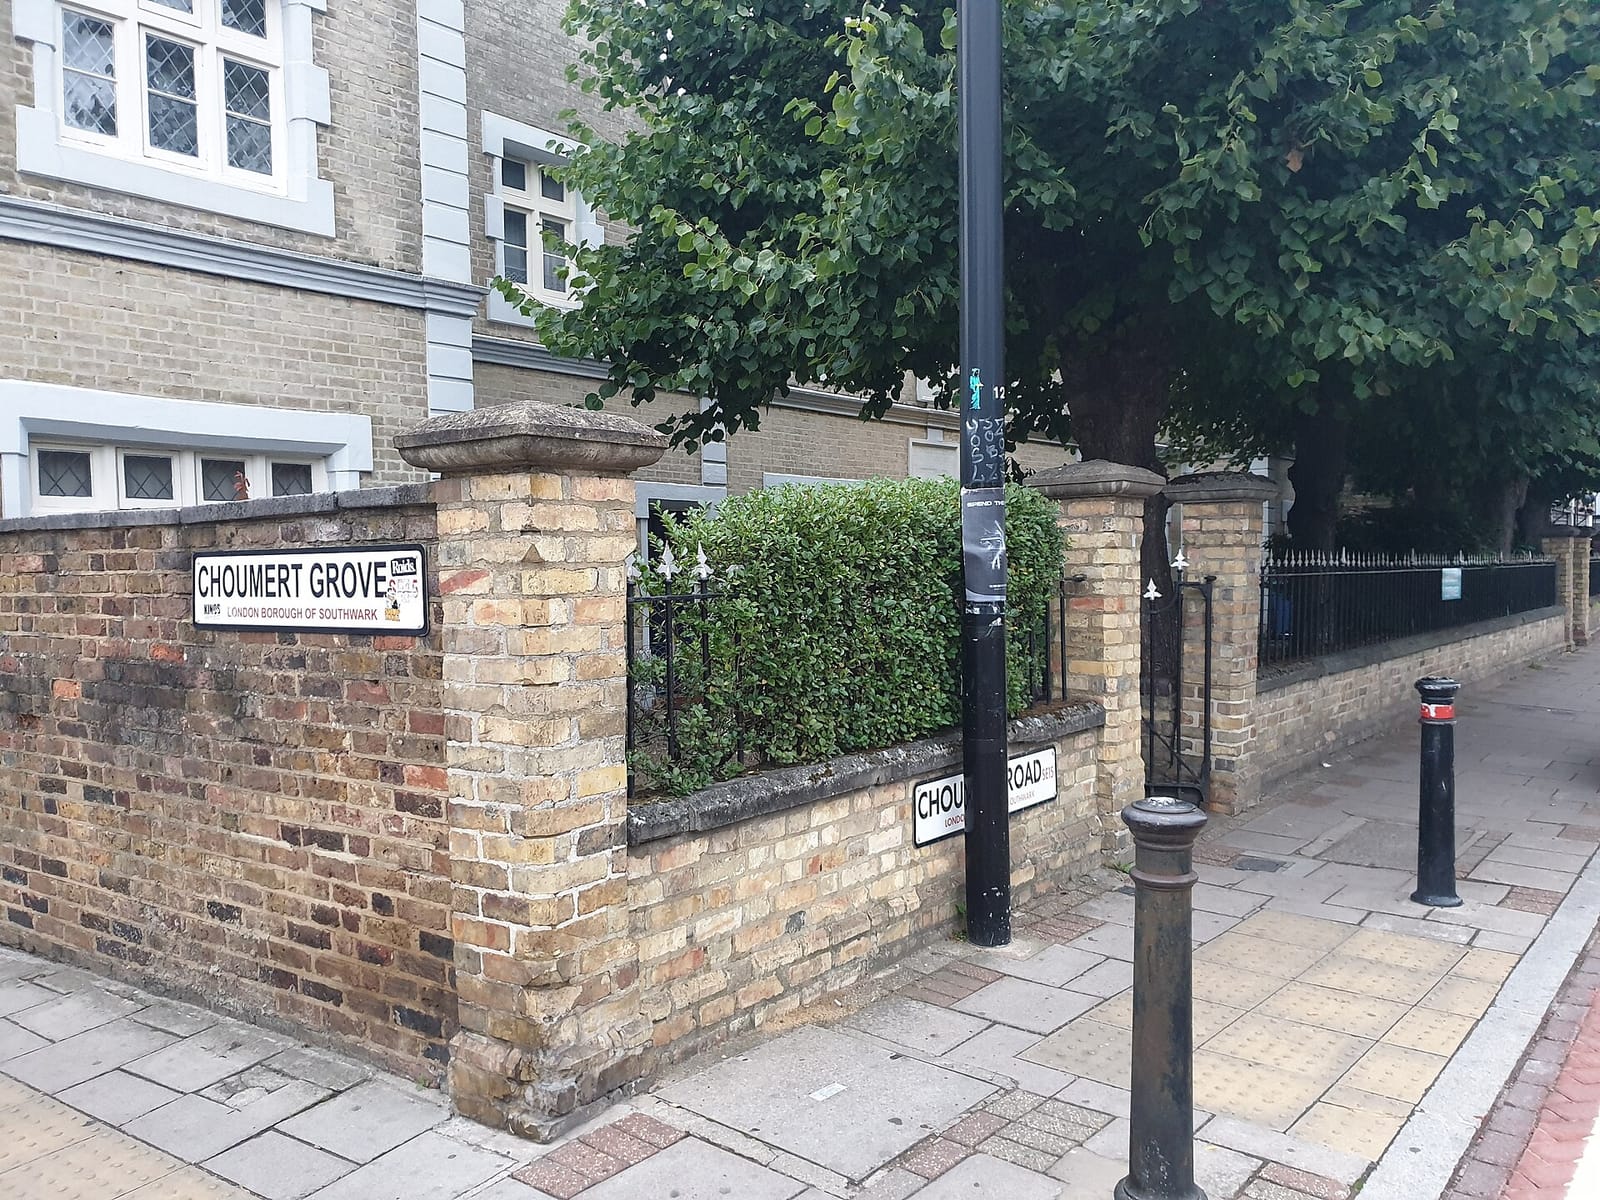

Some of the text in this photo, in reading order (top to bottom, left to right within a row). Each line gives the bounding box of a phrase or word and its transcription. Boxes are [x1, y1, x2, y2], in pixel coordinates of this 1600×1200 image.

[198, 563, 303, 598] CHOUMERT
[310, 562, 387, 598] GROVE
[227, 606, 259, 618] LONDON
[261, 607, 303, 619] BOROUGH
[305, 608, 317, 619] OF
[319, 608, 378, 621] SOUTHWARK
[918, 781, 964, 819] CHOU
[1007, 759, 1042, 791] ROAD
[944, 790, 1035, 828] LONDO OUTHWARK
